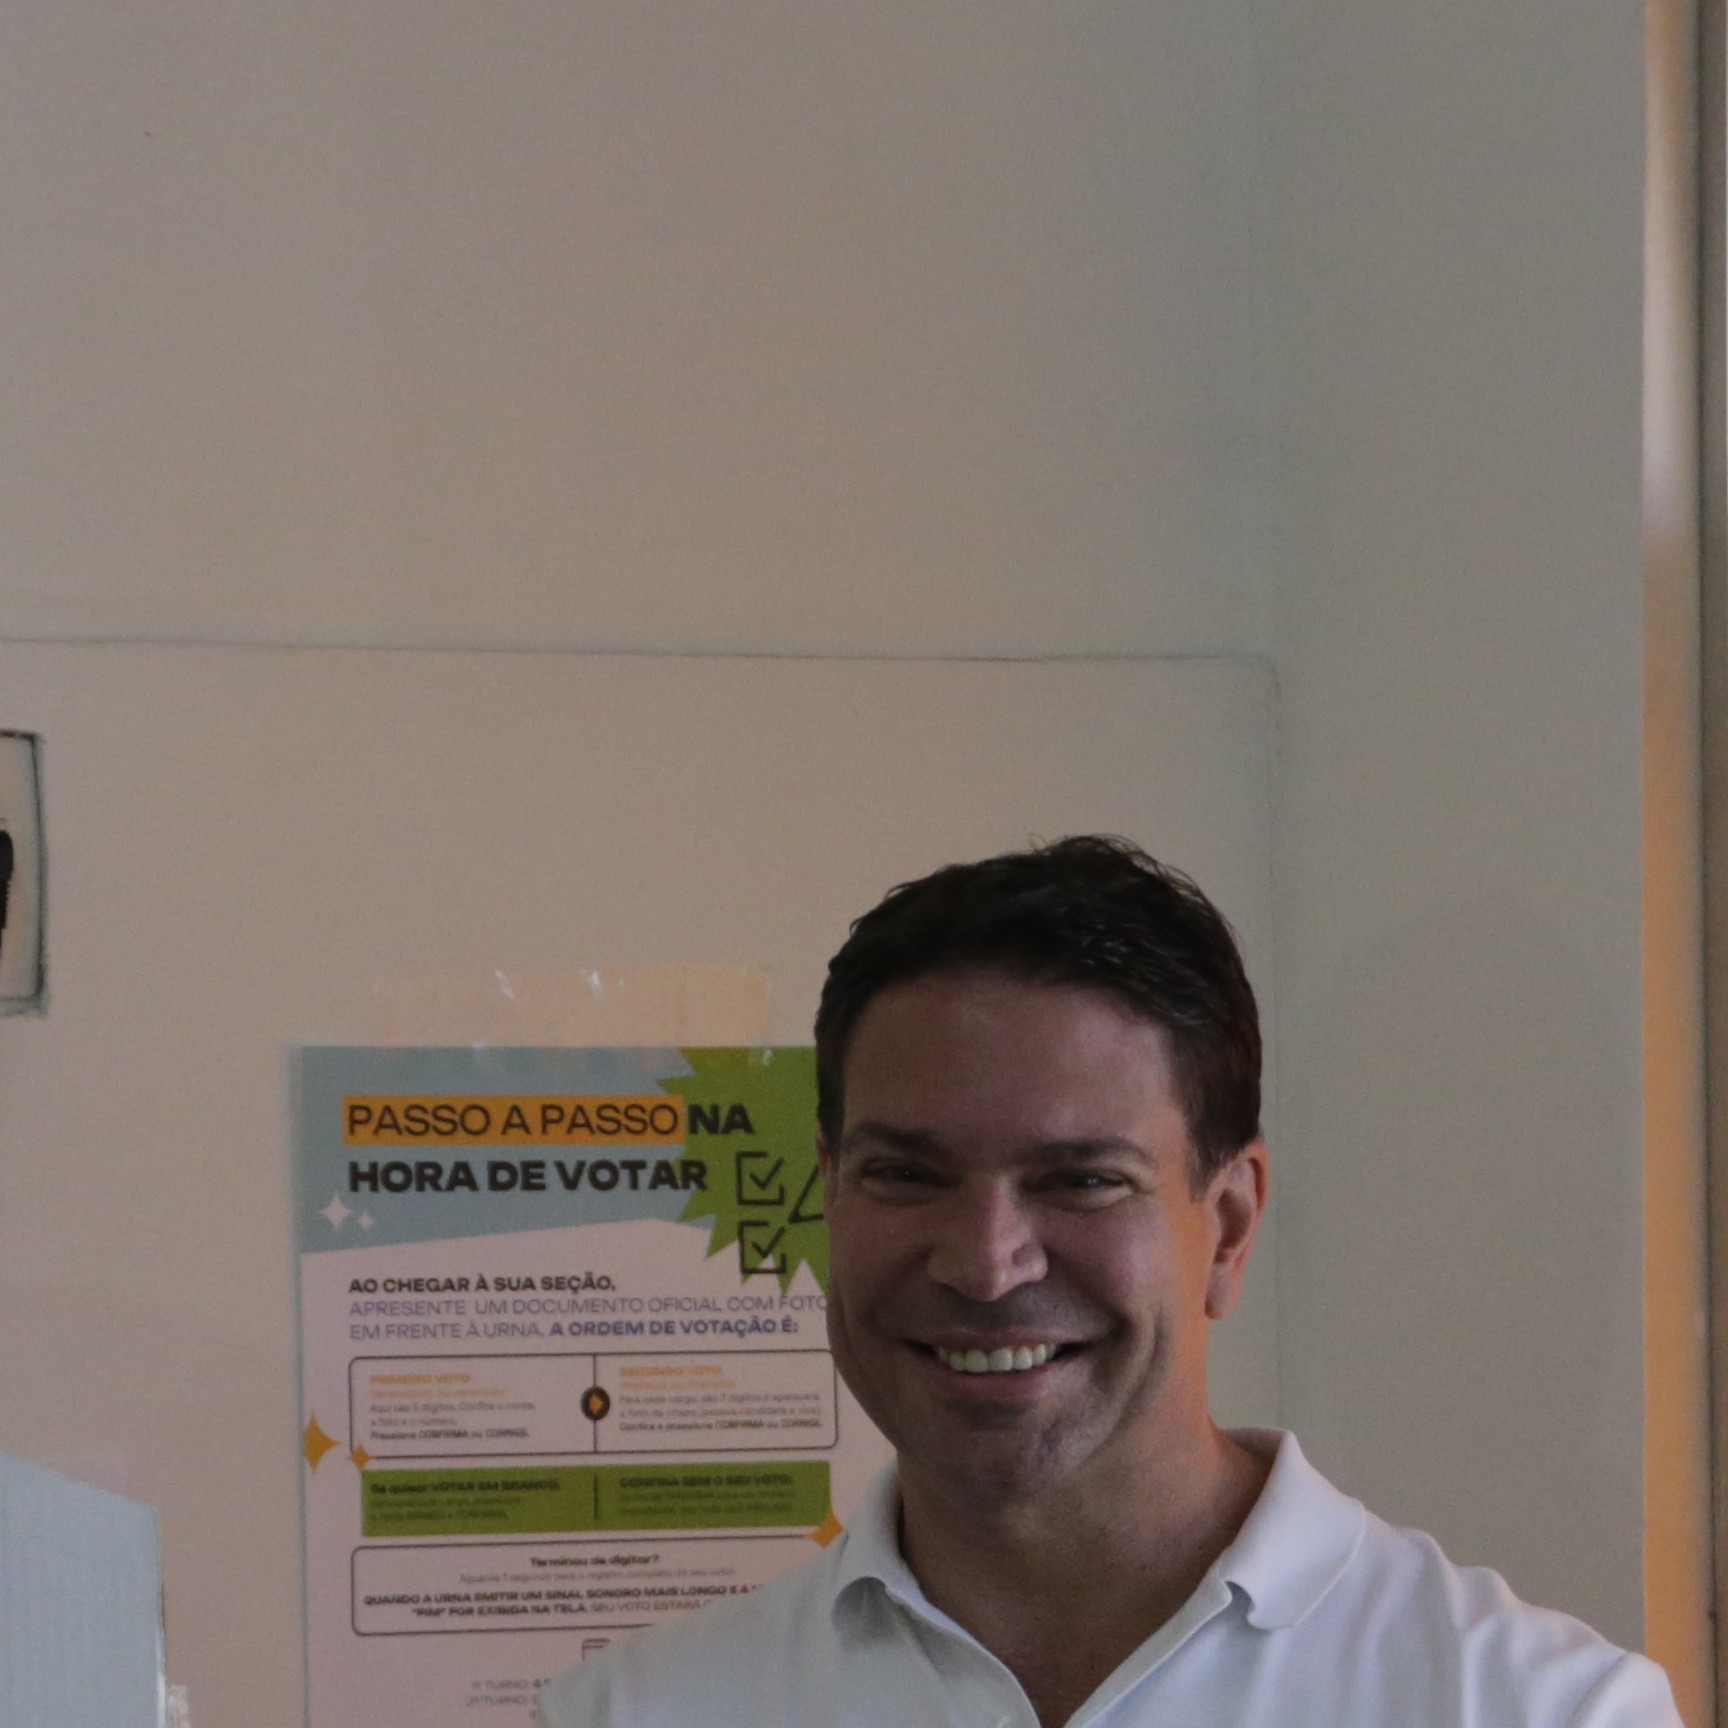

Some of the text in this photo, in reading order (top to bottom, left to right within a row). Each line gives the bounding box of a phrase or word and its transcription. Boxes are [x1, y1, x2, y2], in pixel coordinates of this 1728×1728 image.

[348, 1103, 754, 1136] PASSO A PASSO NA
[348, 1159, 708, 1193] HORA DE VOTAR
[349, 1271, 616, 1294] AO CHEGAR À SUA SEÇÃO,
[349, 1300, 466, 1316] APRESENTE
[475, 1299, 507, 1315] UM
[513, 1297, 644, 1315] DOCUMENTO
[648, 1297, 722, 1313] OFICIAL
[727, 1296, 773, 1312] COM
[350, 1324, 379, 1340] EM
[385, 1322, 462, 1339] FRENTE
[483, 1322, 544, 1338] URNA,
[549, 1322, 564, 1337] A
[568, 1320, 645, 1336] ORDEM
[649, 1319, 676, 1335] DE
[680, 1315, 775, 1338] VOTAÇÃO
[782, 1315, 798, 1334] É:
